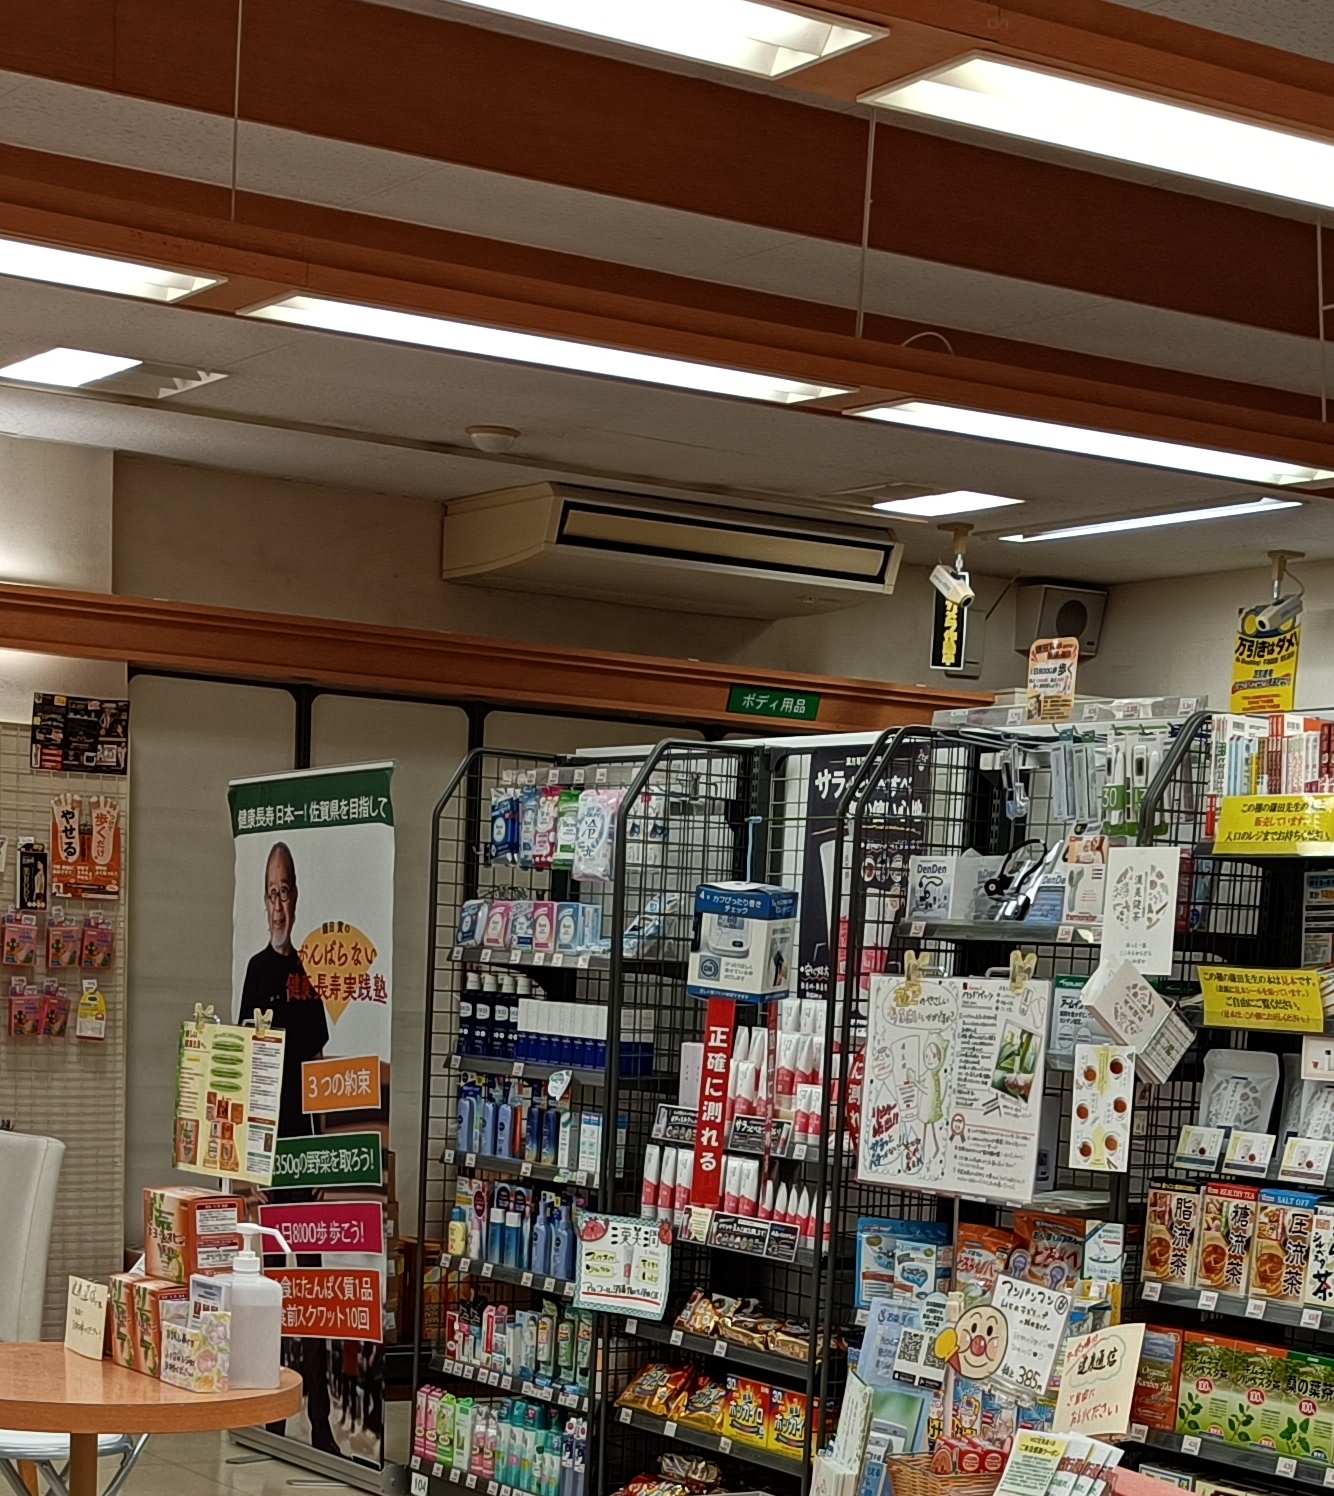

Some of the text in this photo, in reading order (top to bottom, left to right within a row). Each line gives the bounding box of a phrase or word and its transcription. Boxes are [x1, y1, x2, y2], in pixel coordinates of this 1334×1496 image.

[743, 693, 806, 714] ボディ用品
[61, 809, 77, 857] やせる
[95, 813, 108, 857] 歩くだけ
[917, 864, 947, 874] DenDen
[724, 905, 749, 914] チェック
[297, 940, 377, 966] がんばらない
[700, 1026, 729, 1172] 正確に測れる
[1170, 1198, 1193, 1277] 脂流茶
[1225, 1204, 1251, 1286] 糖流茶
[729, 1401, 764, 1422] ホッカイロ
[774, 1413, 805, 1438] ホッカイ
[412, 1478, 427, 1493] 104
